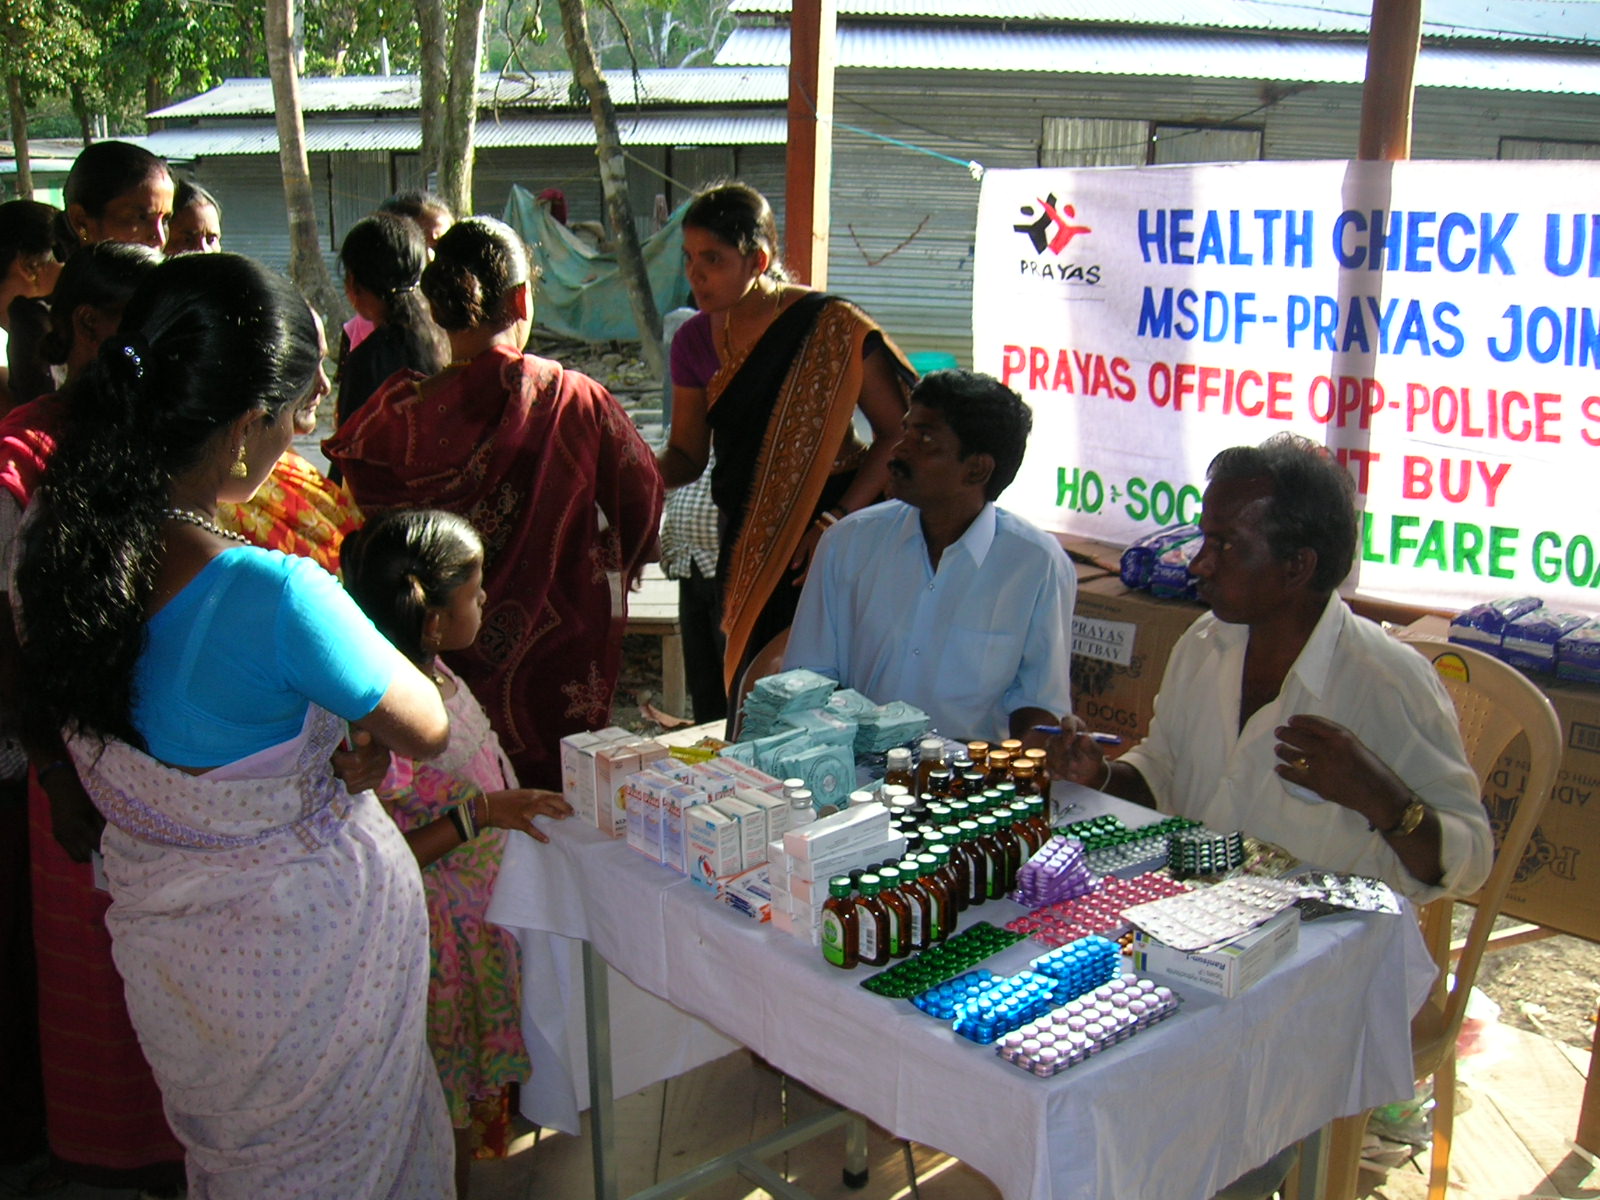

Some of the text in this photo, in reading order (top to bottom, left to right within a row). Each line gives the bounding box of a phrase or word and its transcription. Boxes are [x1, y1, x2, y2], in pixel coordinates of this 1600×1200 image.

[1020, 259, 1101, 286] PRAYAS
[1138, 208, 1315, 268] HEALTH
[1332, 210, 1520, 276] CHECK
[1137, 286, 1465, 359] MSDF-PRAYAS
[1002, 344, 1137, 403] PRAYAS
[1148, 362, 1294, 421] OFFICE
[1308, 375, 1562, 444] OPP-POLICE
[1402, 454, 1512, 507] BUY
[1353, 510, 1520, 580] LFARE
[1086, 701, 1138, 728] DOGS
